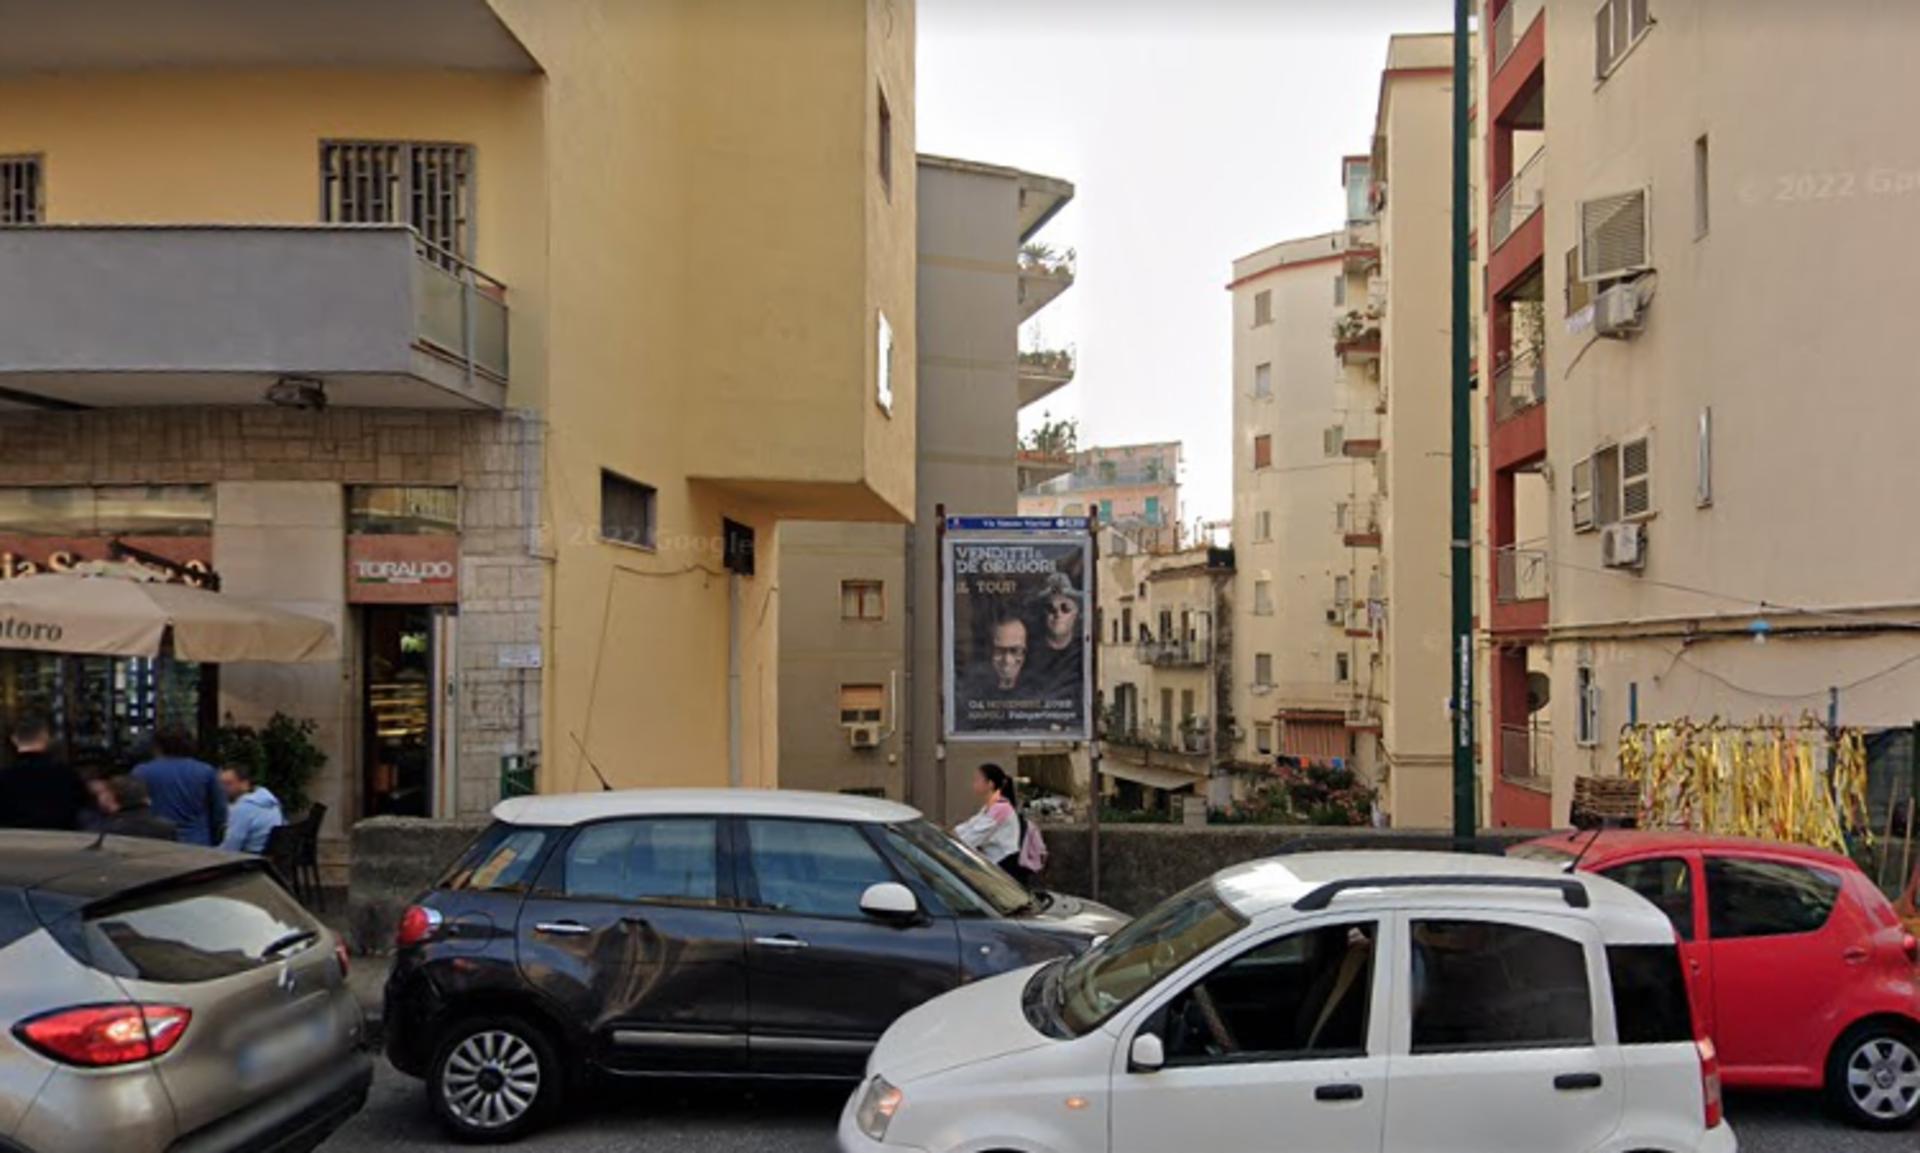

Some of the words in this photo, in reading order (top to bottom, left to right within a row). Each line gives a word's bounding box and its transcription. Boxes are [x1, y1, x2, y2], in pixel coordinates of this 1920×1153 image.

[955, 546, 1034, 560] VENDITTI
[353, 561, 453, 578] TORALDO
[956, 560, 979, 574] DE
[982, 560, 1057, 574] GREGORI
